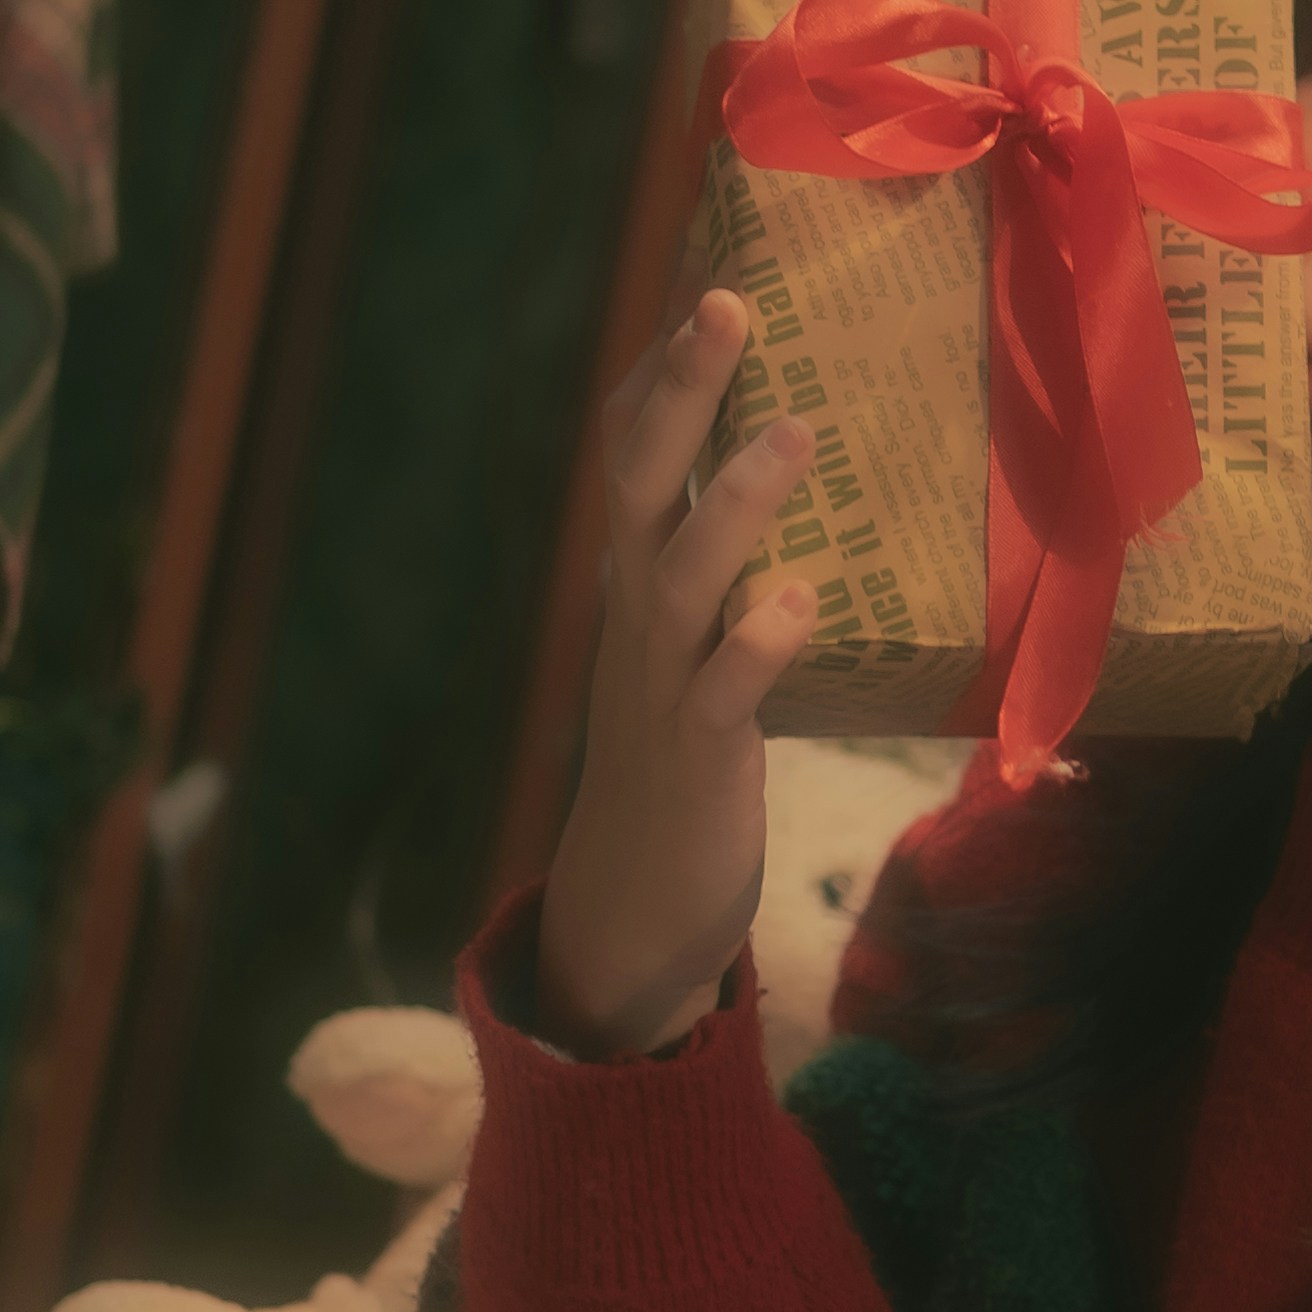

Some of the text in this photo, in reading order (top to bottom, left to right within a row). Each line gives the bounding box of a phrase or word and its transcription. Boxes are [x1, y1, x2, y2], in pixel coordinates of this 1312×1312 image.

[1213, 15, 1258, 89] OF
[840, 195, 864, 228] can
[864, 260, 891, 301] Also
[883, 242, 918, 307] earnest
[930, 246, 961, 294] gram
[1275, 262, 1290, 298] from
[855, 301, 876, 322] to
[1277, 304, 1292, 366] answer
[831, 356, 853, 381] go
[897, 343, 925, 393] came
[951, 369, 972, 393] no
[1218, 250, 1268, 475] LITTLE
[772, 353, 829, 417] be
[840, 387, 859, 407] to
[1278, 372, 1292, 398] the
[890, 393, 916, 432] Dick
[963, 398, 981, 415] is
[916, 396, 955, 468] critiques
[853, 356, 944, 566] church every Sunday and
[947, 471, 969, 500] my
[832, 517, 884, 561] it
[935, 511, 957, 540] the
[1243, 507, 1266, 540] The
[1273, 525, 1294, 554] the
[894, 533, 928, 589] where
[945, 540, 965, 560] of
[1194, 565, 1214, 587] to
[1207, 569, 1250, 608] port
